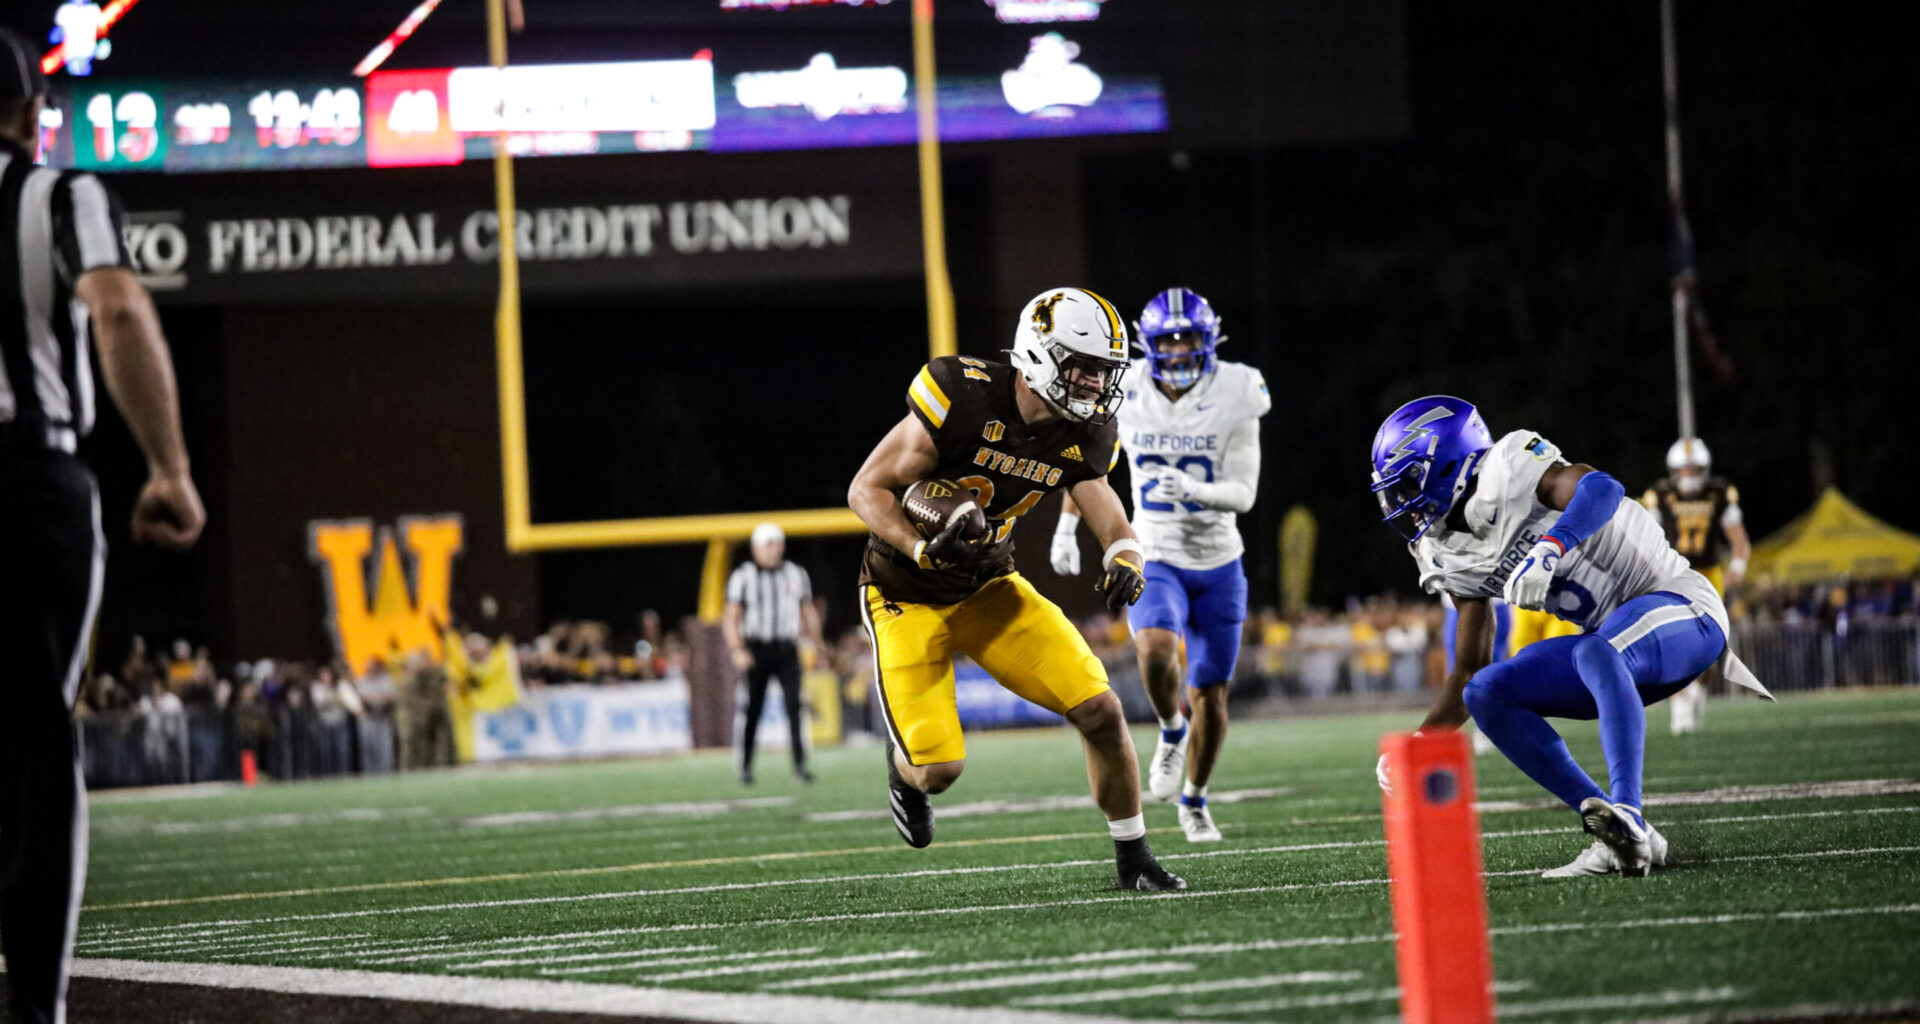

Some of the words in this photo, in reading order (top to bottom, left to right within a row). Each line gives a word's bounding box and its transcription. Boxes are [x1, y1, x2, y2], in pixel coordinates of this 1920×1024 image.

[121, 221, 188, 274] YO
[207, 212, 455, 273] FEDERAL
[668, 194, 851, 253] UNION
[973, 446, 1064, 487] WYOMING
[1132, 431, 1155, 450] AIR
[1159, 433, 1217, 452] FORCE
[1494, 528, 1542, 585] FORCE
[307, 513, 463, 679] W
